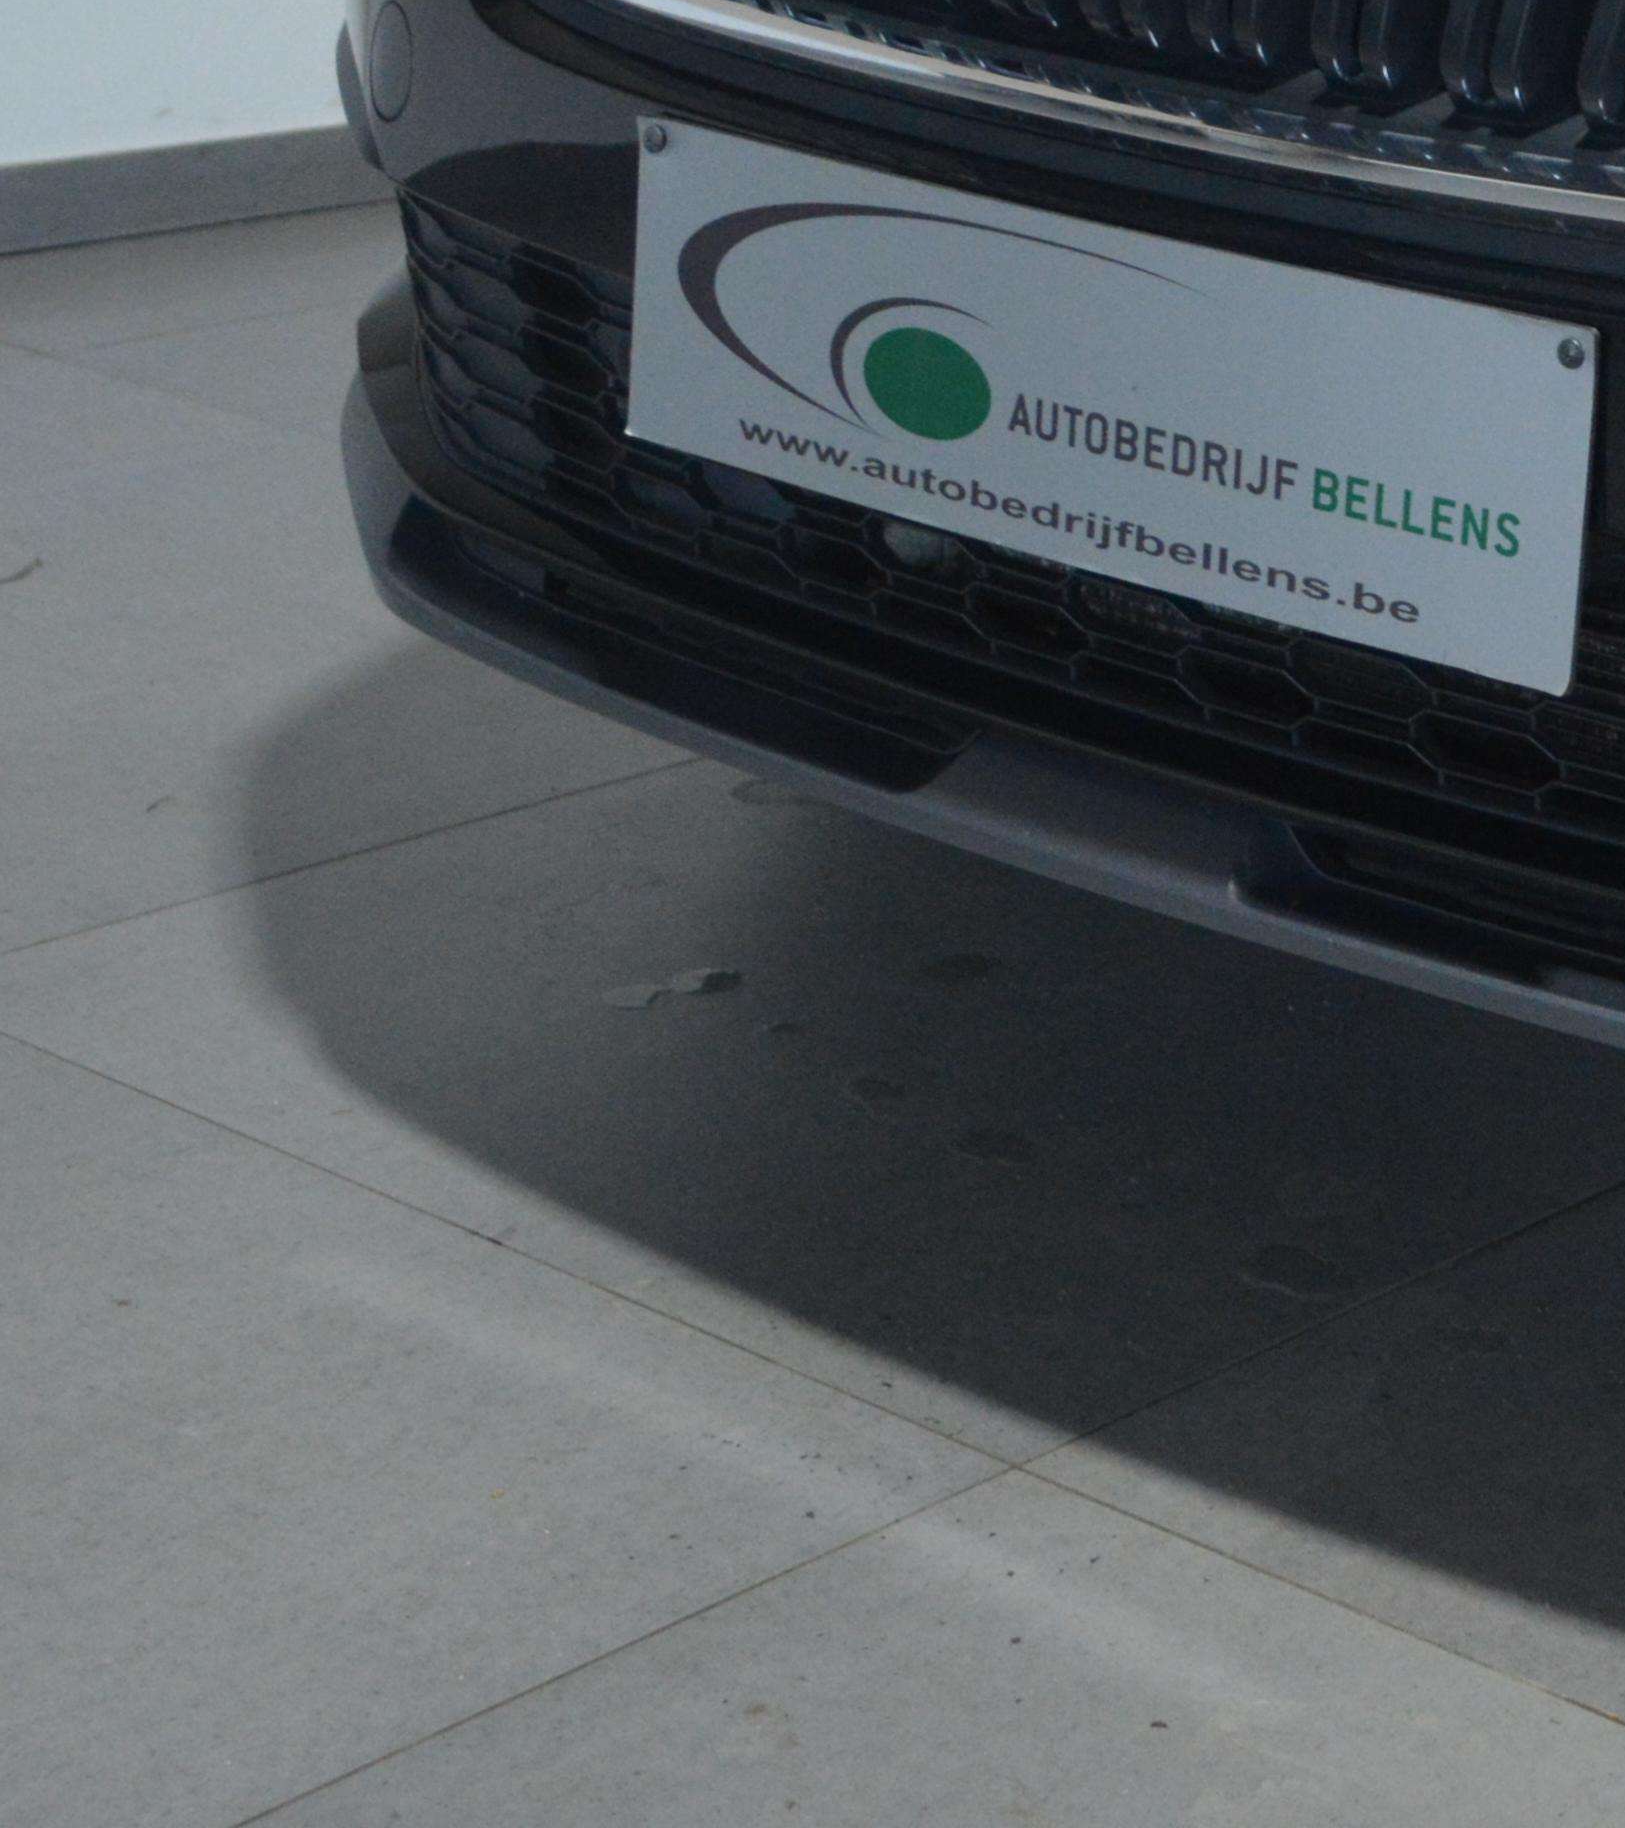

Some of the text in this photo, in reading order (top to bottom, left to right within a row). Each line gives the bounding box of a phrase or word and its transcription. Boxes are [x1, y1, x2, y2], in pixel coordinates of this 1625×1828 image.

[739, 418, 1420, 623] www.autobedrijfbellens.be
[1008, 393, 1521, 558] AUTOBEDRIJF BELLENS
